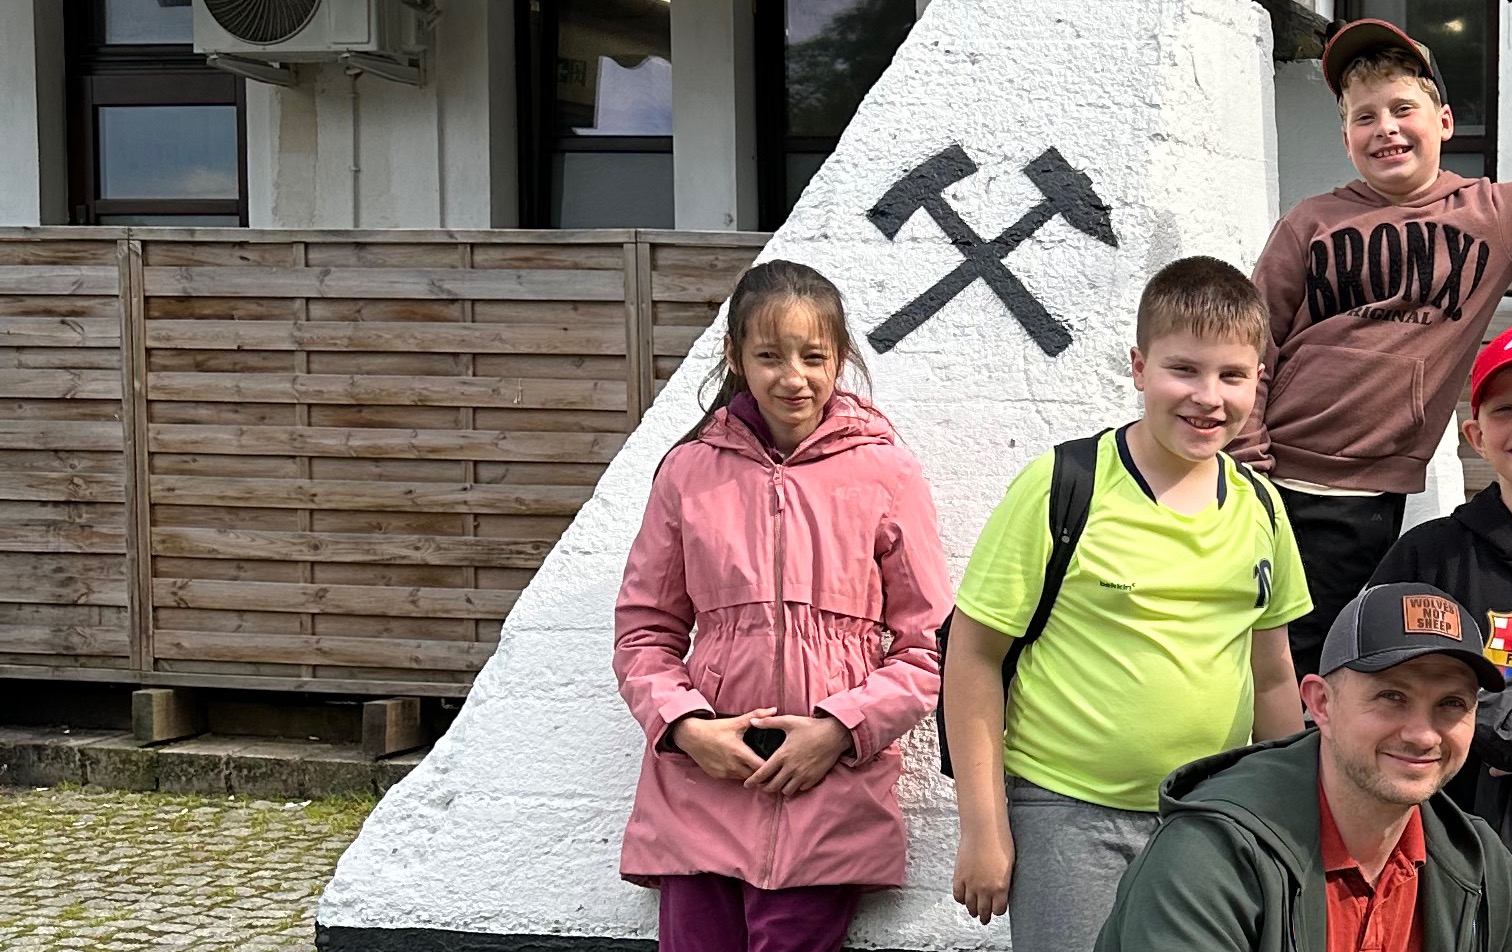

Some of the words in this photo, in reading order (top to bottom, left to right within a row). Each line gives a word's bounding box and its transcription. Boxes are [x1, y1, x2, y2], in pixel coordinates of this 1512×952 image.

[1306, 221, 1490, 324] BRONX!
[1346, 306, 1433, 325] RIGINAL
[1410, 598, 1455, 614] WOLVES
[1422, 608, 1446, 621] NOT
[1416, 618, 1453, 634] SHEEP
